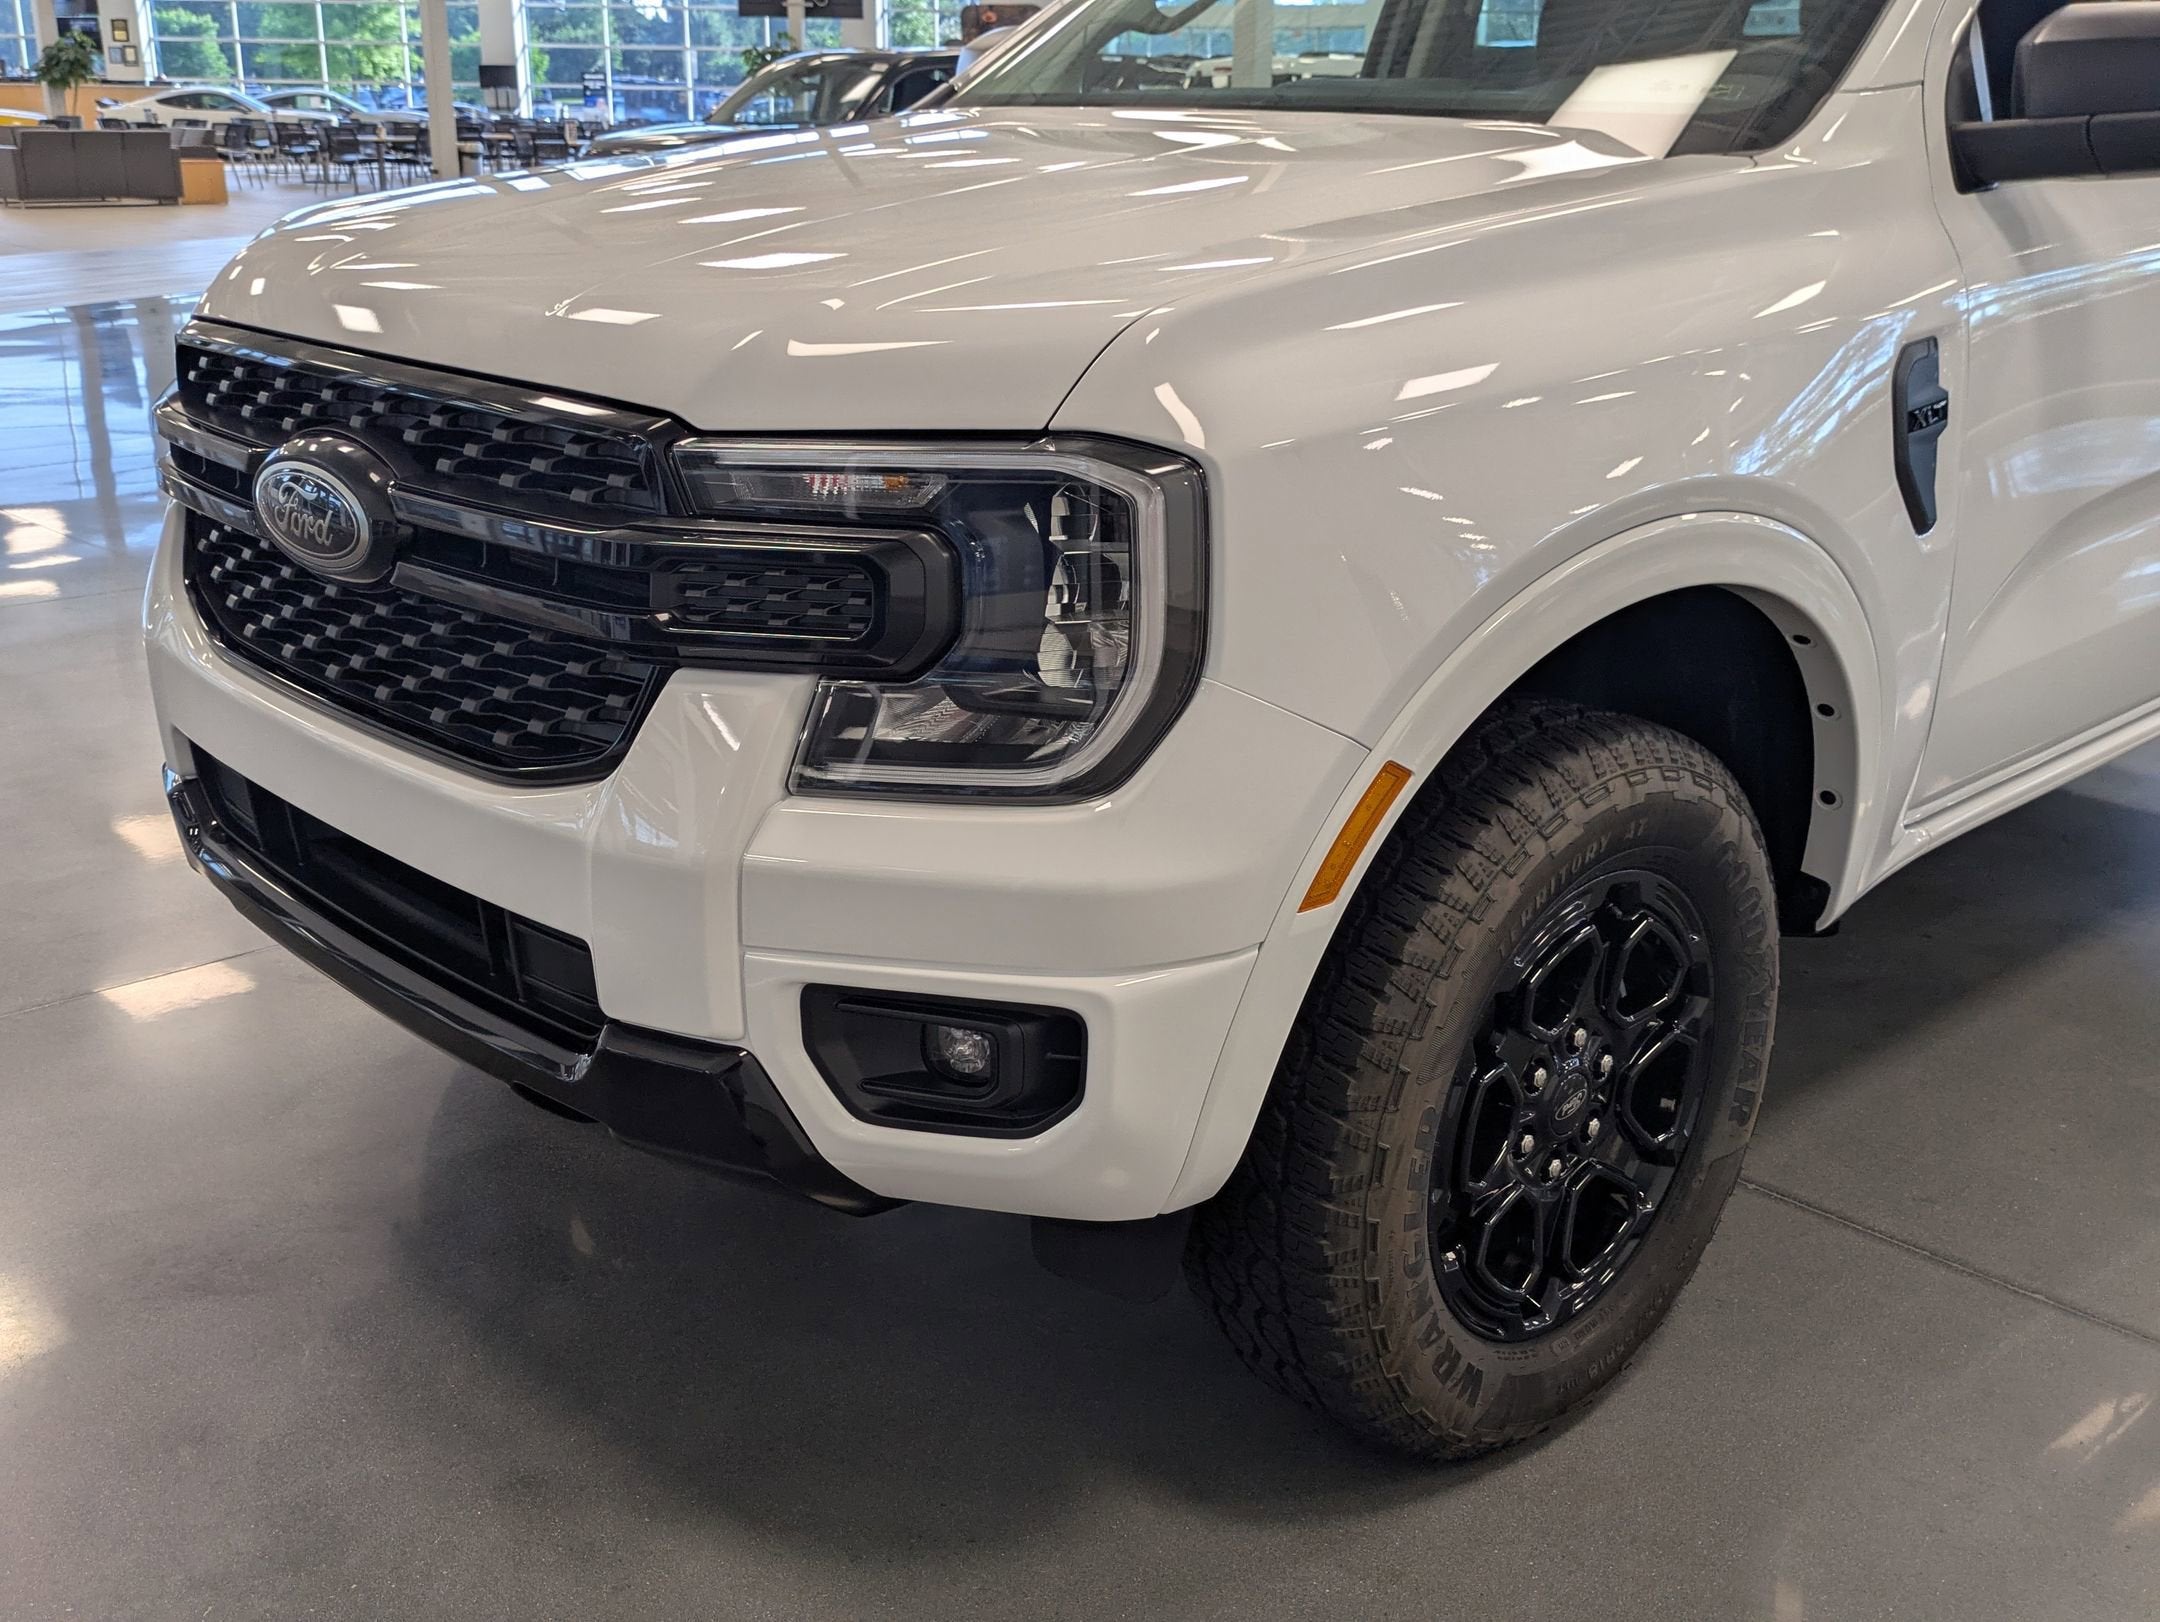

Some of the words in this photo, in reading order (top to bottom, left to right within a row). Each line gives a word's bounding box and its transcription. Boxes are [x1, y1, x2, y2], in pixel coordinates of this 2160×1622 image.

[1913, 400, 1948, 431] XLT
[273, 482, 334, 547] Ford
[1499, 832, 1612, 958] TERRITORY
[1712, 840, 1771, 1127] GOODYEAR
[1561, 1092, 1583, 1117] Ford
[1402, 1106, 1484, 1409] WRANGLER
